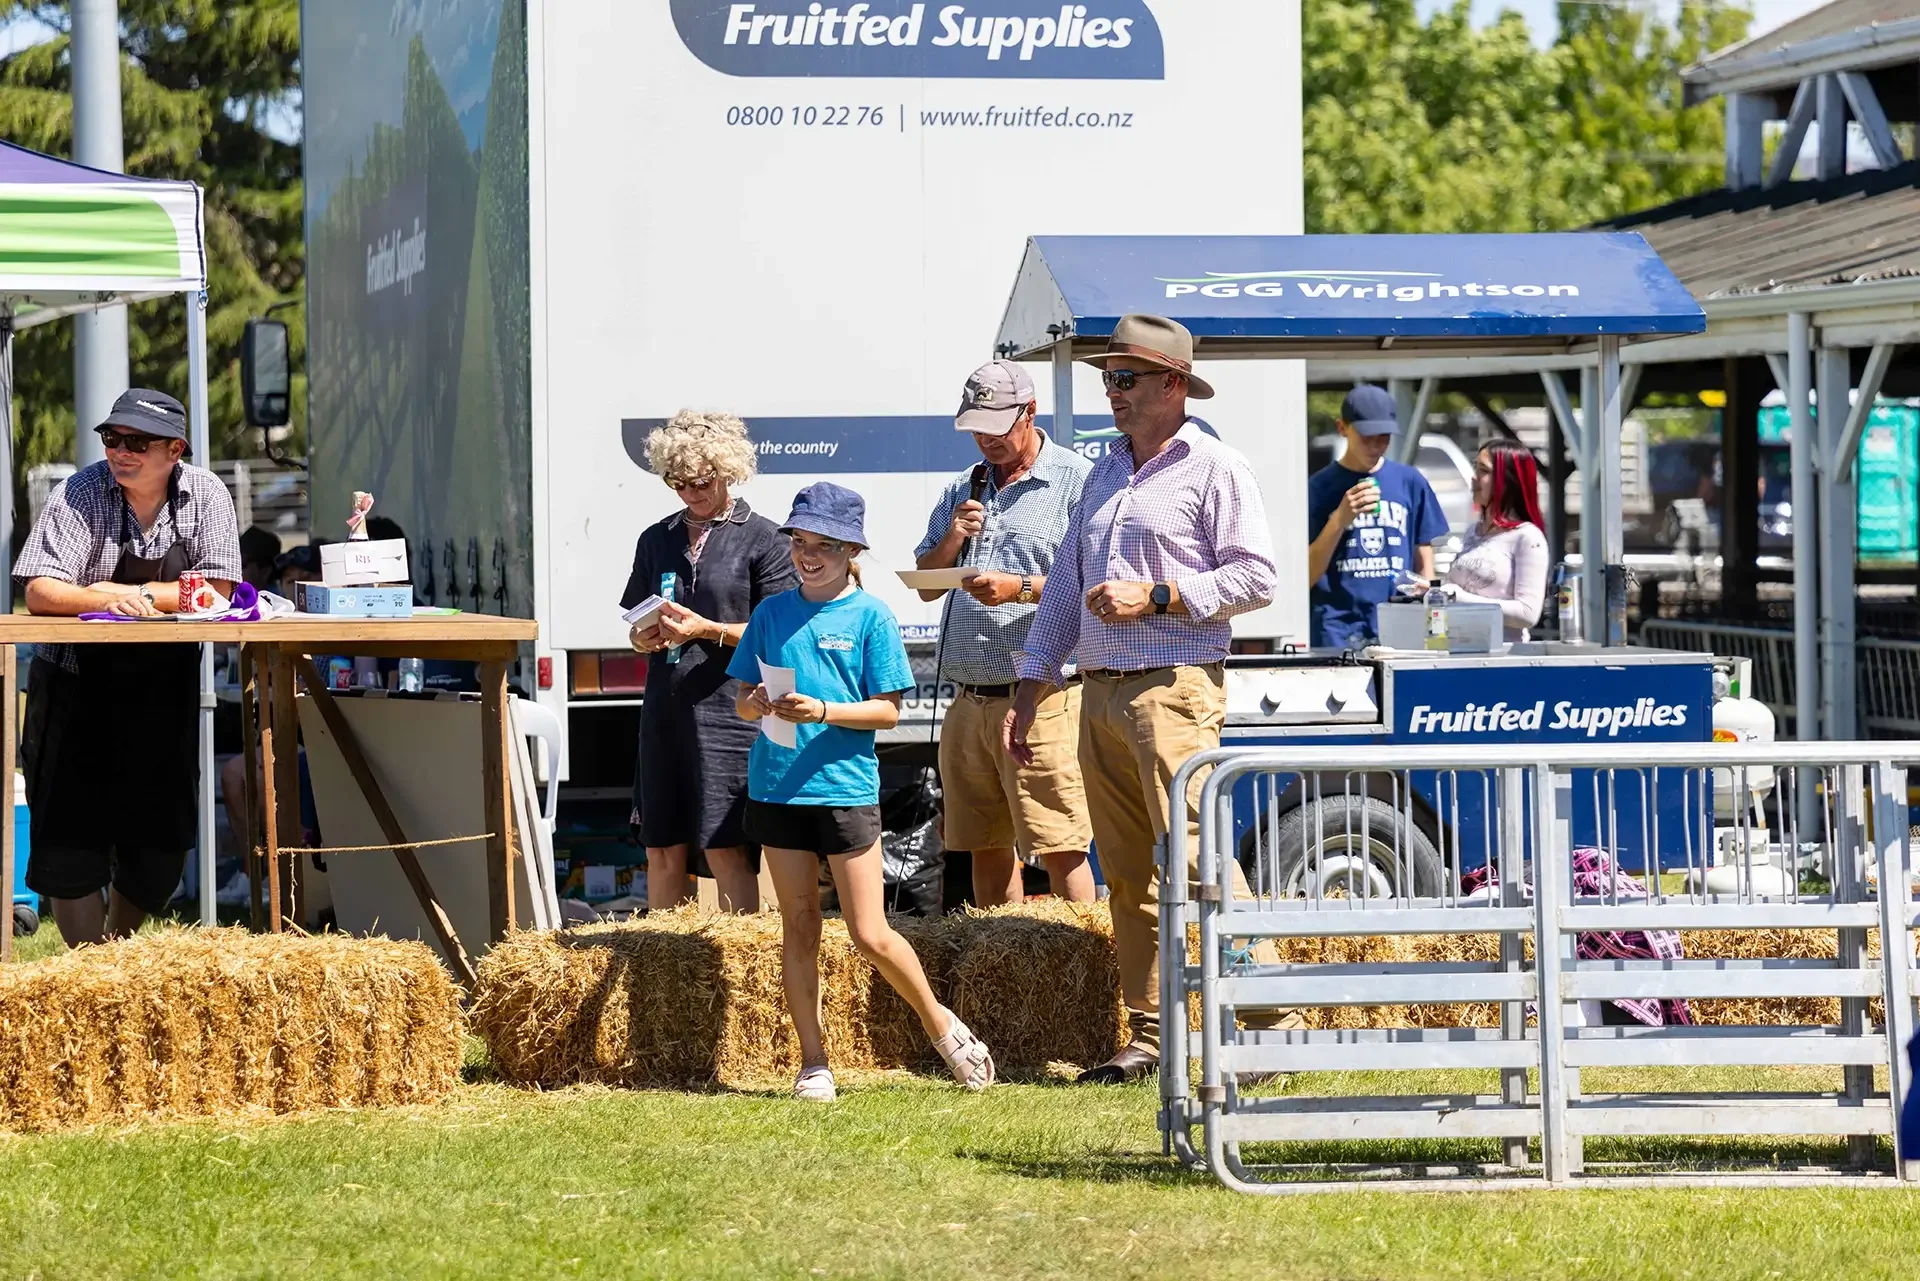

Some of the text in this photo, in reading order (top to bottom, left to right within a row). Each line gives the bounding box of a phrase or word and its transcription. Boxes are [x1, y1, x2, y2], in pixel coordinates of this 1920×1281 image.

[723, 2, 1134, 61] Fruitfed Supplies
[726, 105, 1134, 128] 0800 10 22 76 www.fruitfed.co.nz
[1165, 281, 1580, 302] PGG Wrightson
[760, 440, 783, 454] the
[784, 440, 839, 458] country
[1408, 697, 1688, 737] Fruitfed Supplies
